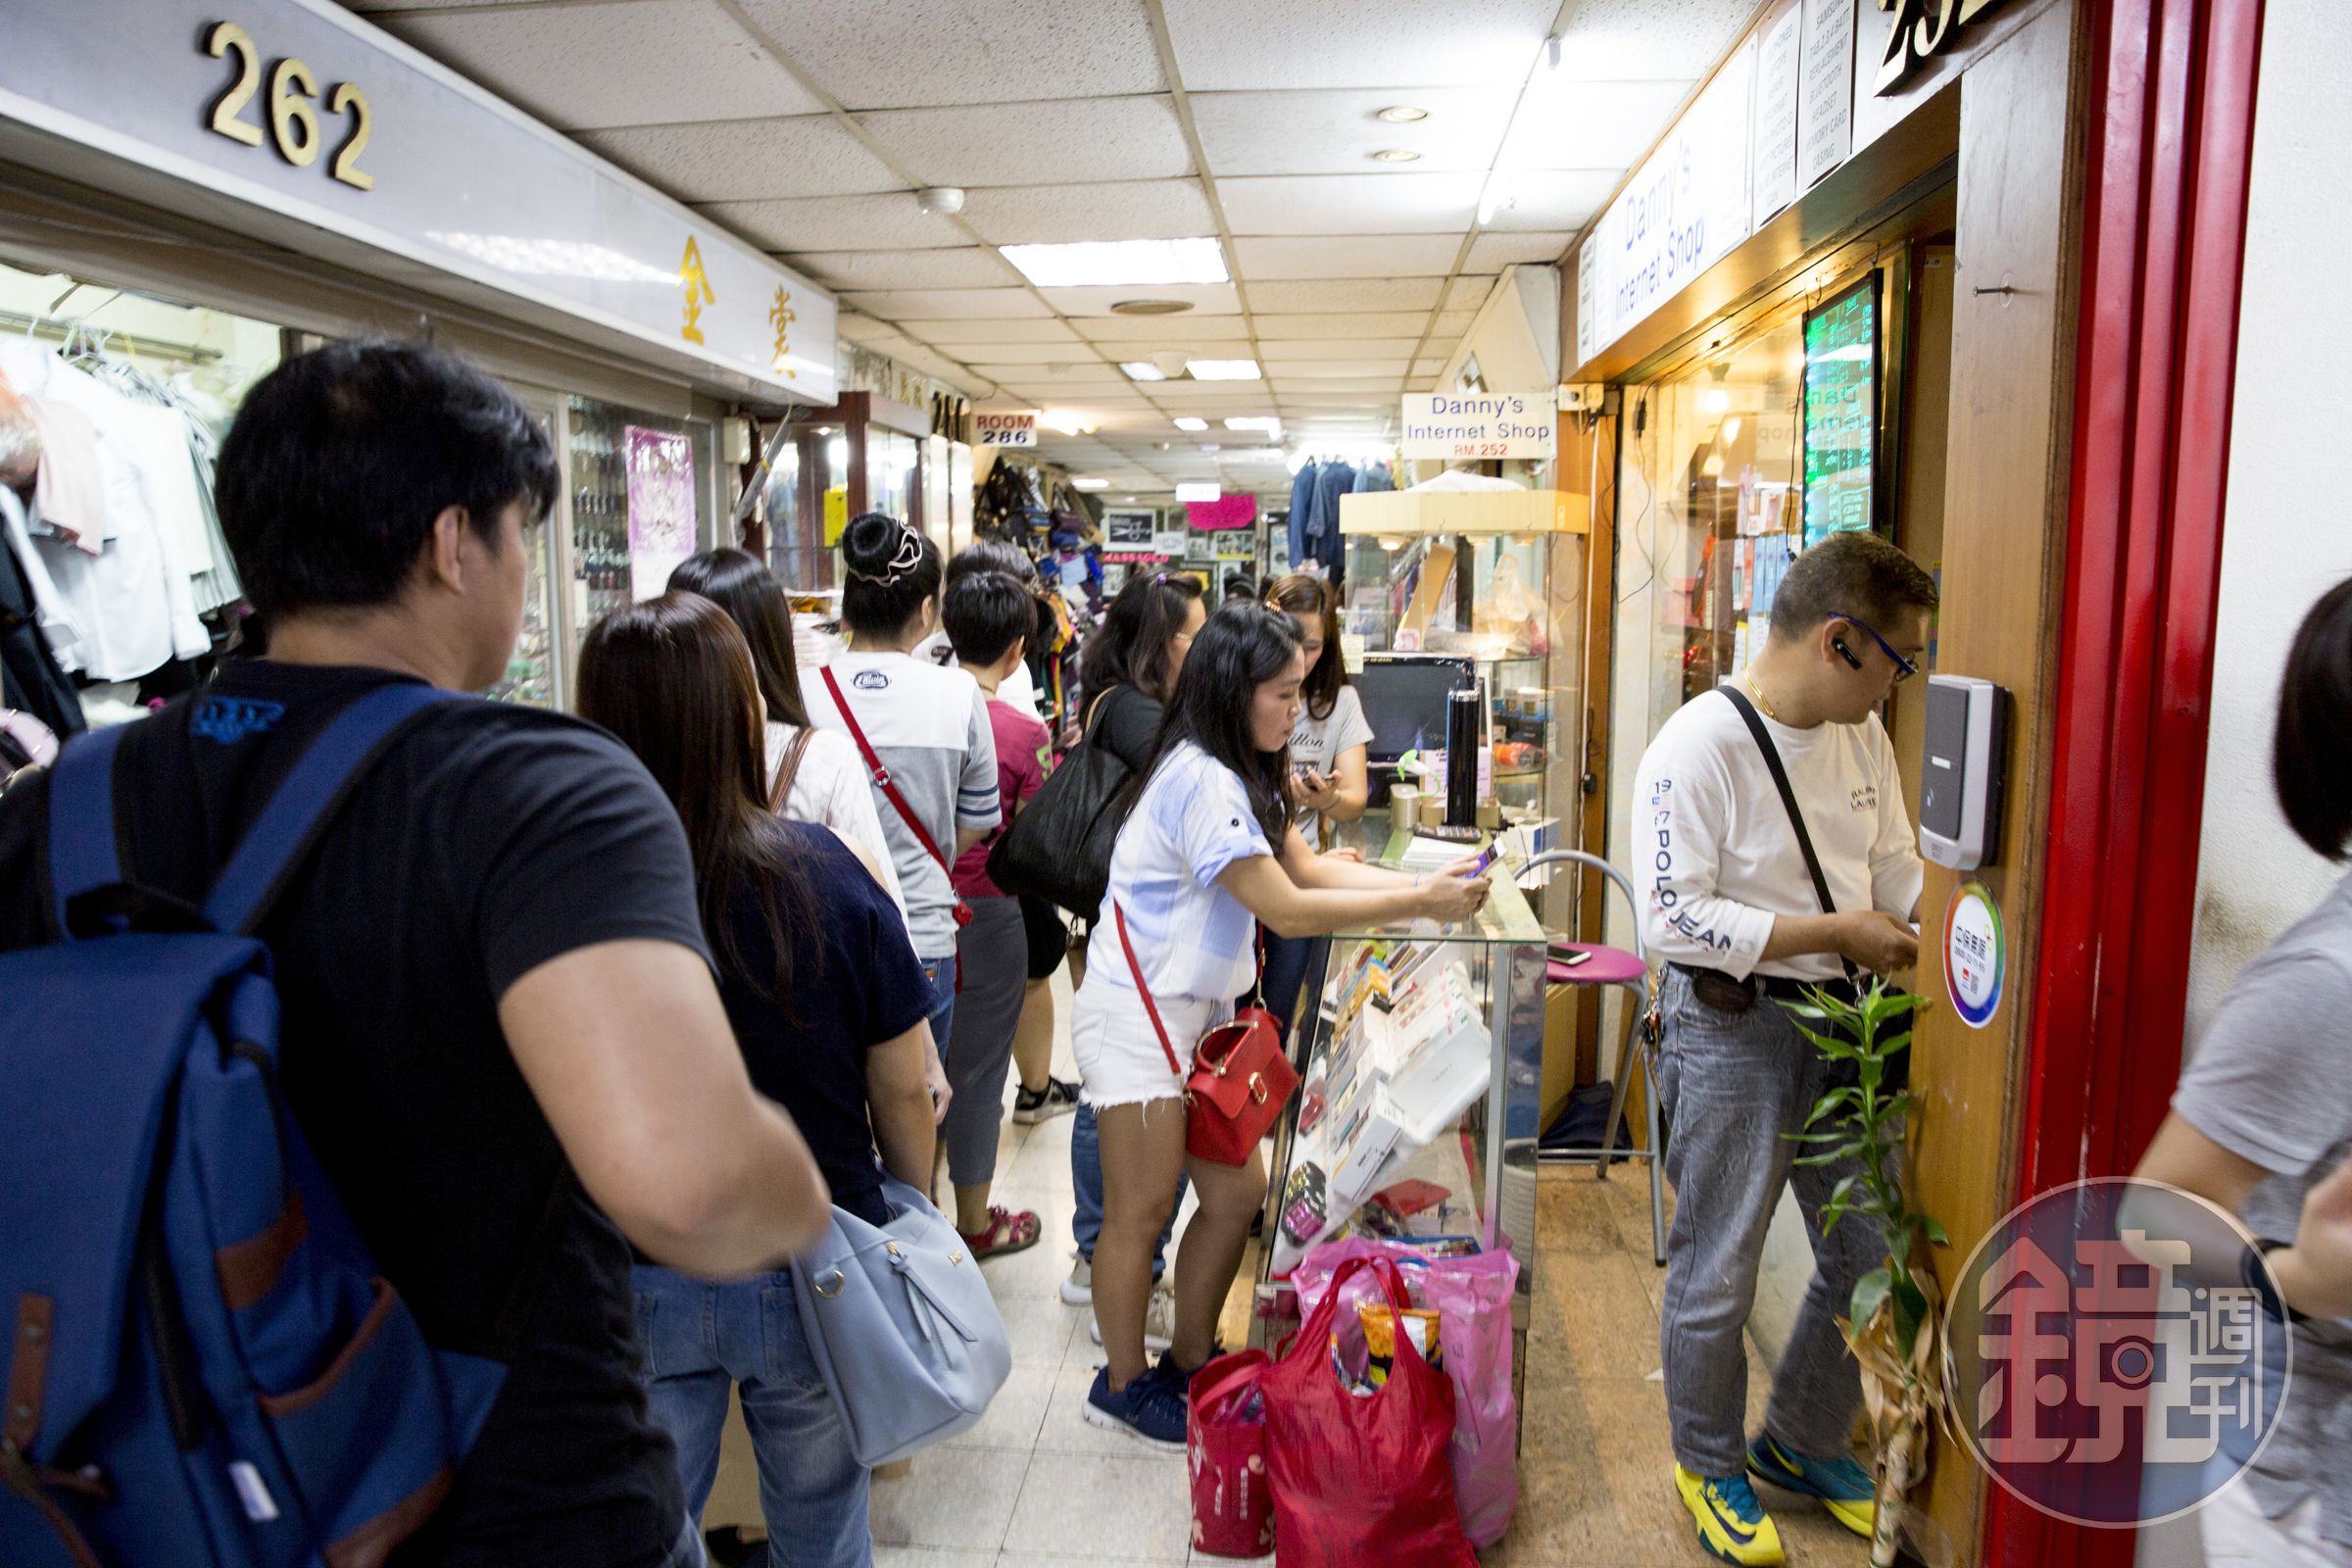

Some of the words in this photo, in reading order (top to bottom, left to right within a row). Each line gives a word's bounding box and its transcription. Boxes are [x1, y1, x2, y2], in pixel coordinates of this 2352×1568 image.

[1808, 32, 1849, 82] REPLACEMENT
[1809, 61, 1842, 105] BLUETOOTH
[205, 21, 374, 190] 262
[1811, 90, 1838, 124] HEADSET
[1830, 109, 1847, 136] CARD
[1811, 141, 1836, 171] CASING
[1626, 138, 1691, 252] Danny's
[1615, 250, 1661, 322] Internet
[1667, 217, 1705, 280] Shop
[977, 415, 1033, 429] ROOM
[1432, 396, 1524, 418] Danny's
[983, 430, 1027, 444] 286
[1408, 424, 1486, 439] Internet
[1497, 422, 1549, 441] Shop
